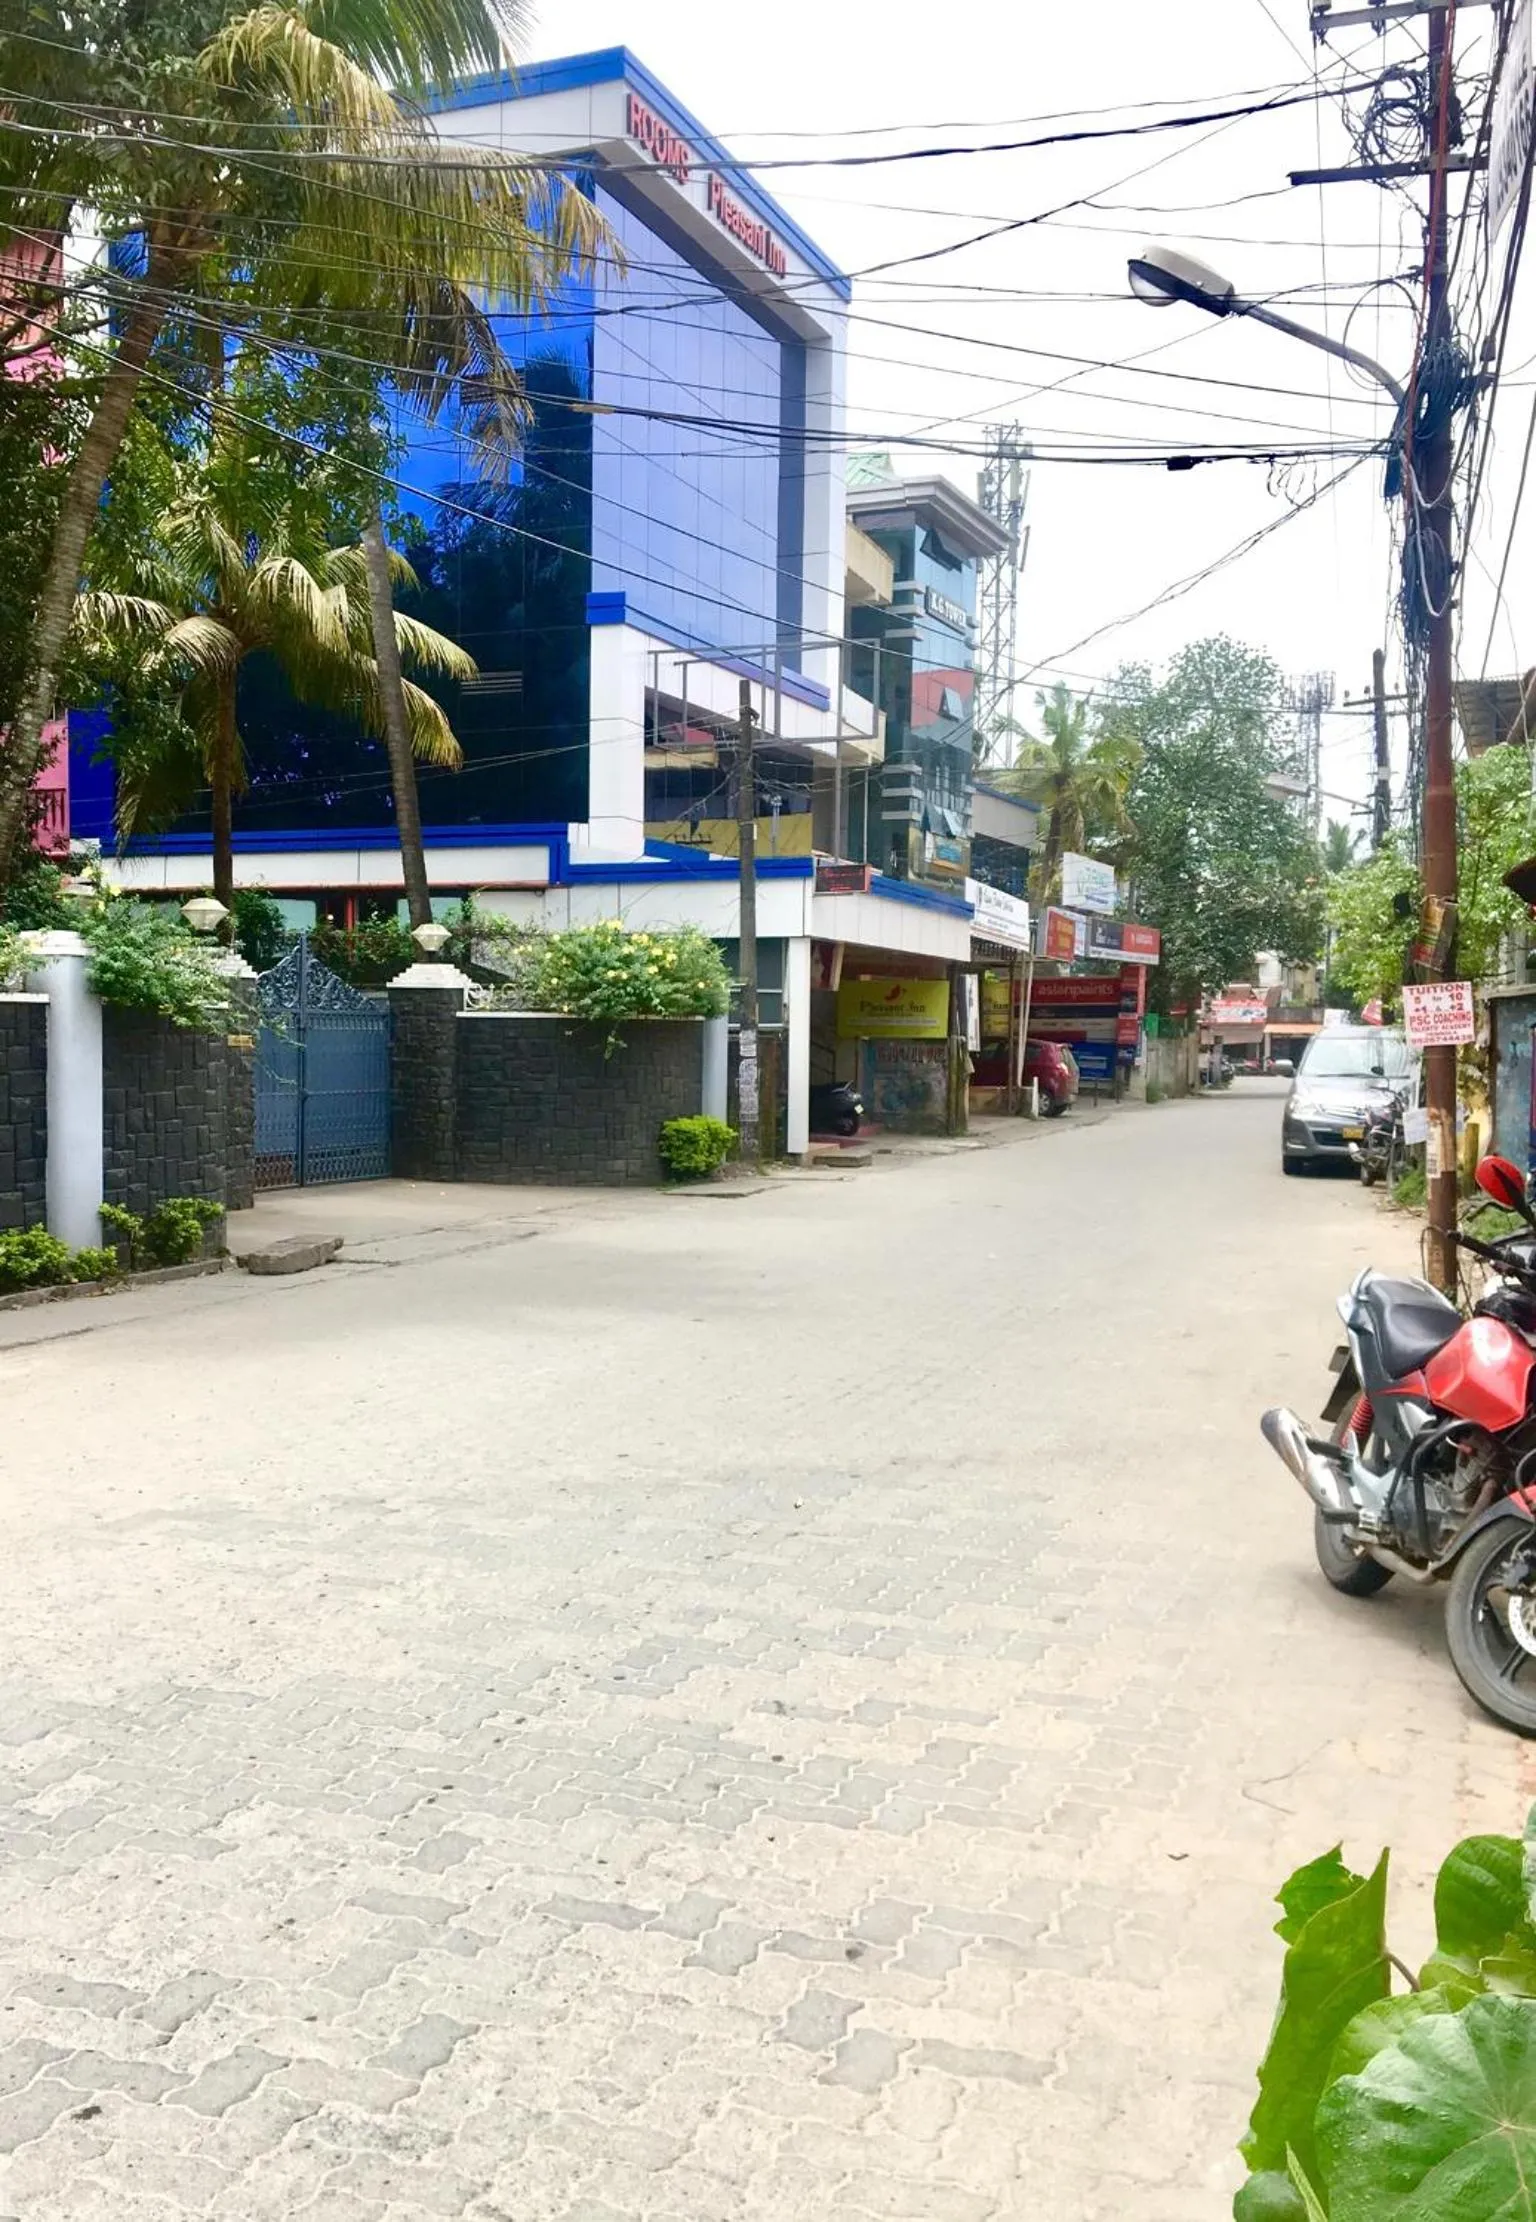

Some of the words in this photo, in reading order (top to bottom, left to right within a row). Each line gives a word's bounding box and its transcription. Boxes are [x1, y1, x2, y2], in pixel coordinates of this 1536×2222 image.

[627, 93, 690, 186] ROOMS
[708, 173, 766, 259] Pleasant
[766, 230, 786, 279] Inn
[1038, 982, 1114, 1000] asianpaints
[1449, 991, 1463, 1002] 10
[1410, 1014, 1431, 1027] PSC
[1433, 1011, 1472, 1025] COACHING
